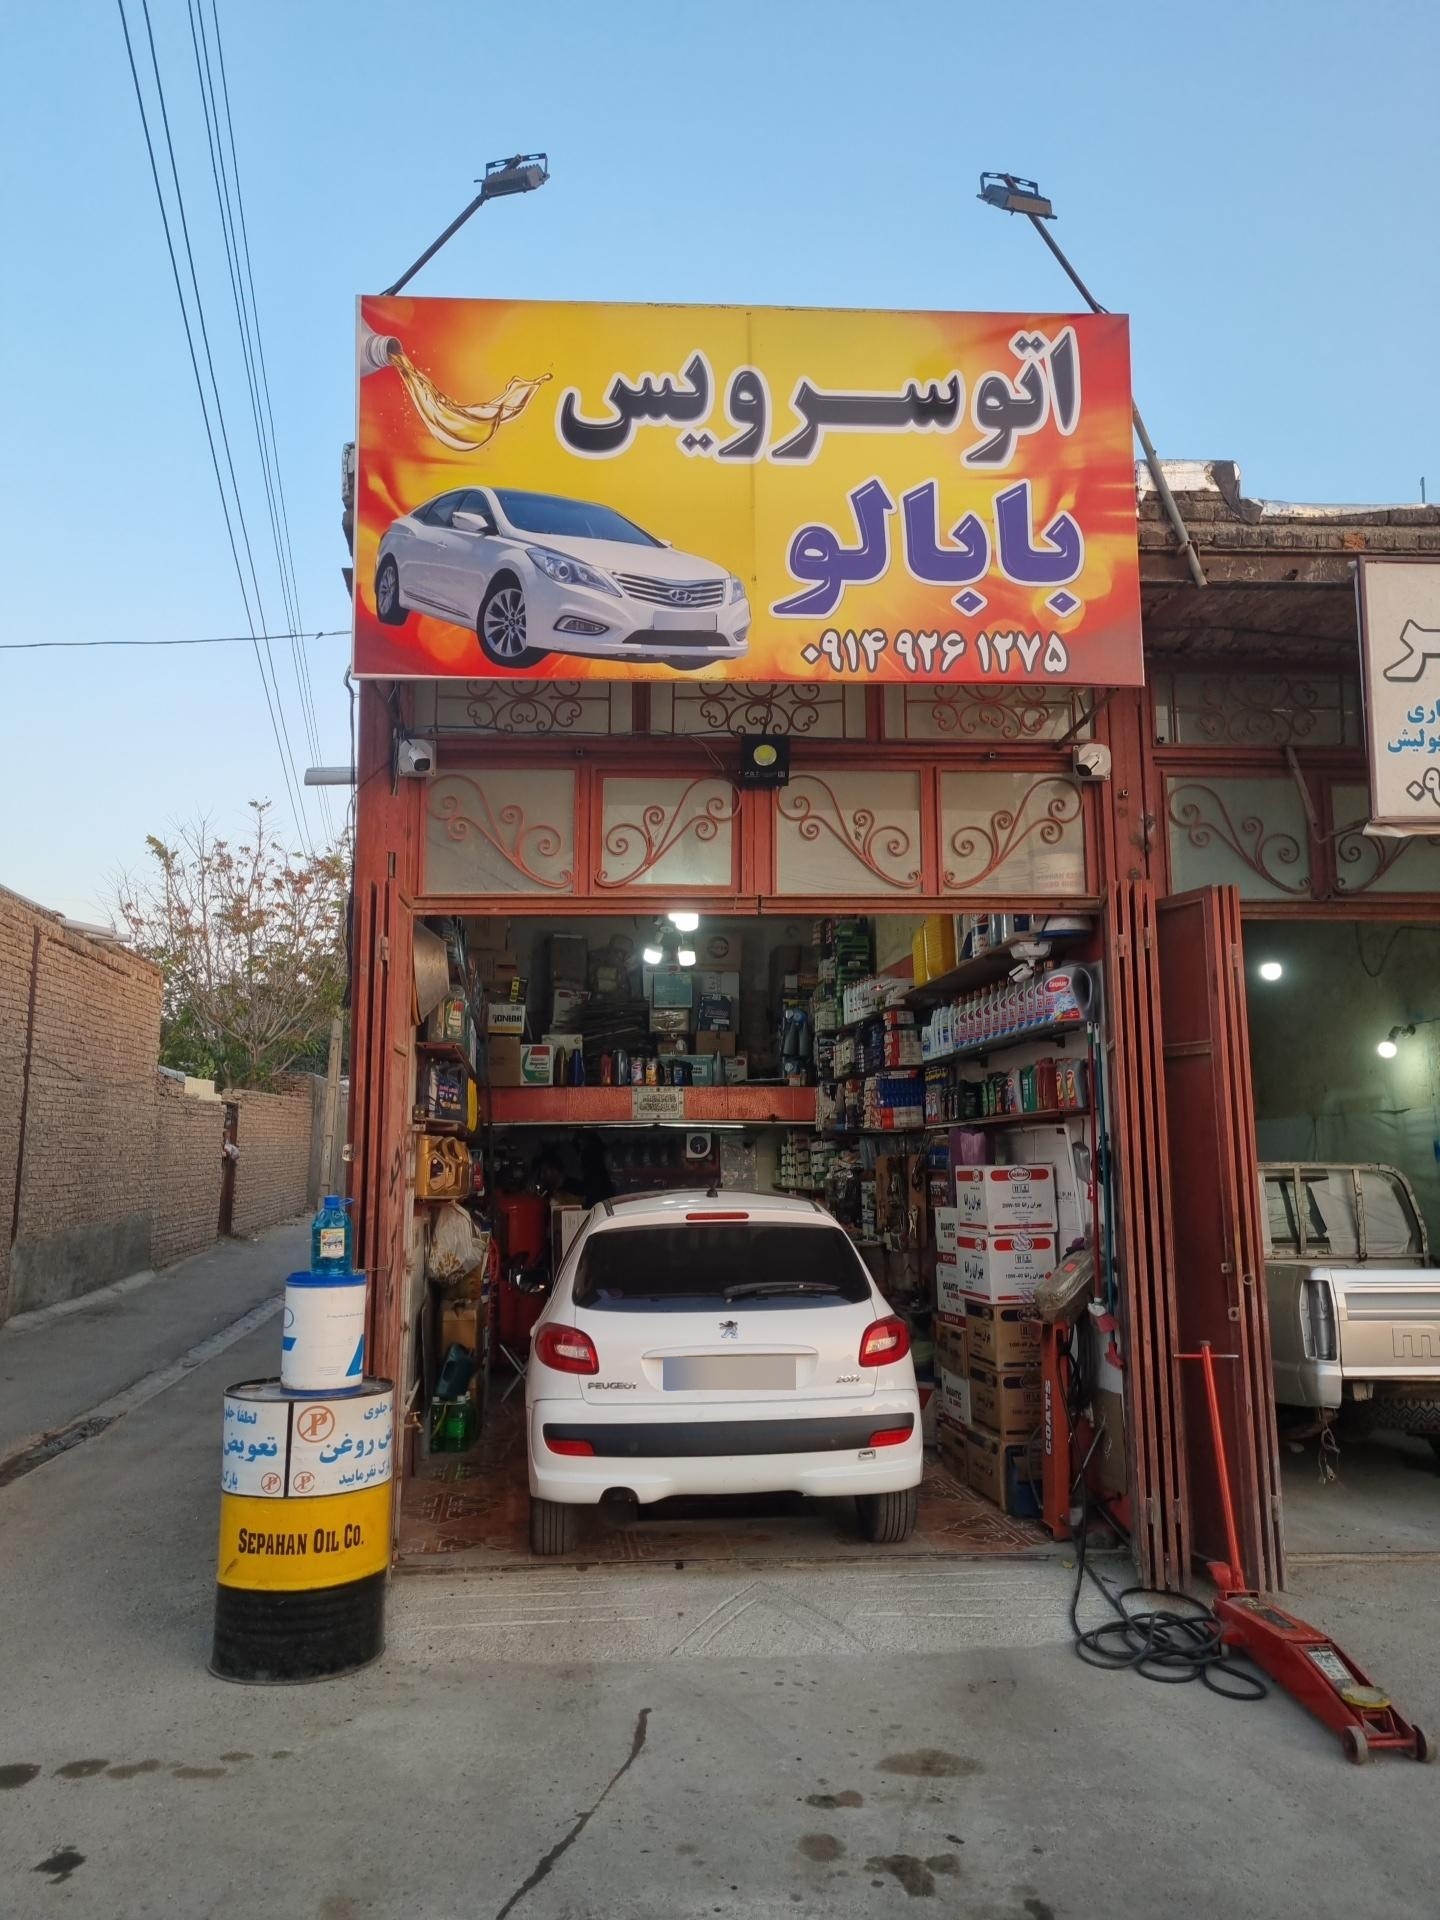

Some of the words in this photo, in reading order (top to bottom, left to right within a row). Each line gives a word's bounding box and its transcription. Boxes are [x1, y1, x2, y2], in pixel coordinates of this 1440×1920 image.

[772, 478, 1084, 618] بابالو
[801, 628, 888, 672] ۰۹۱۴
[894, 629, 967, 673] ۹۲۶
[587, 1382, 638, 1390] PEUGEOT
[319, 1433, 375, 1463] روغن
[238, 1527, 308, 1555] SEPAHAN
[313, 1528, 339, 1553] OIL
